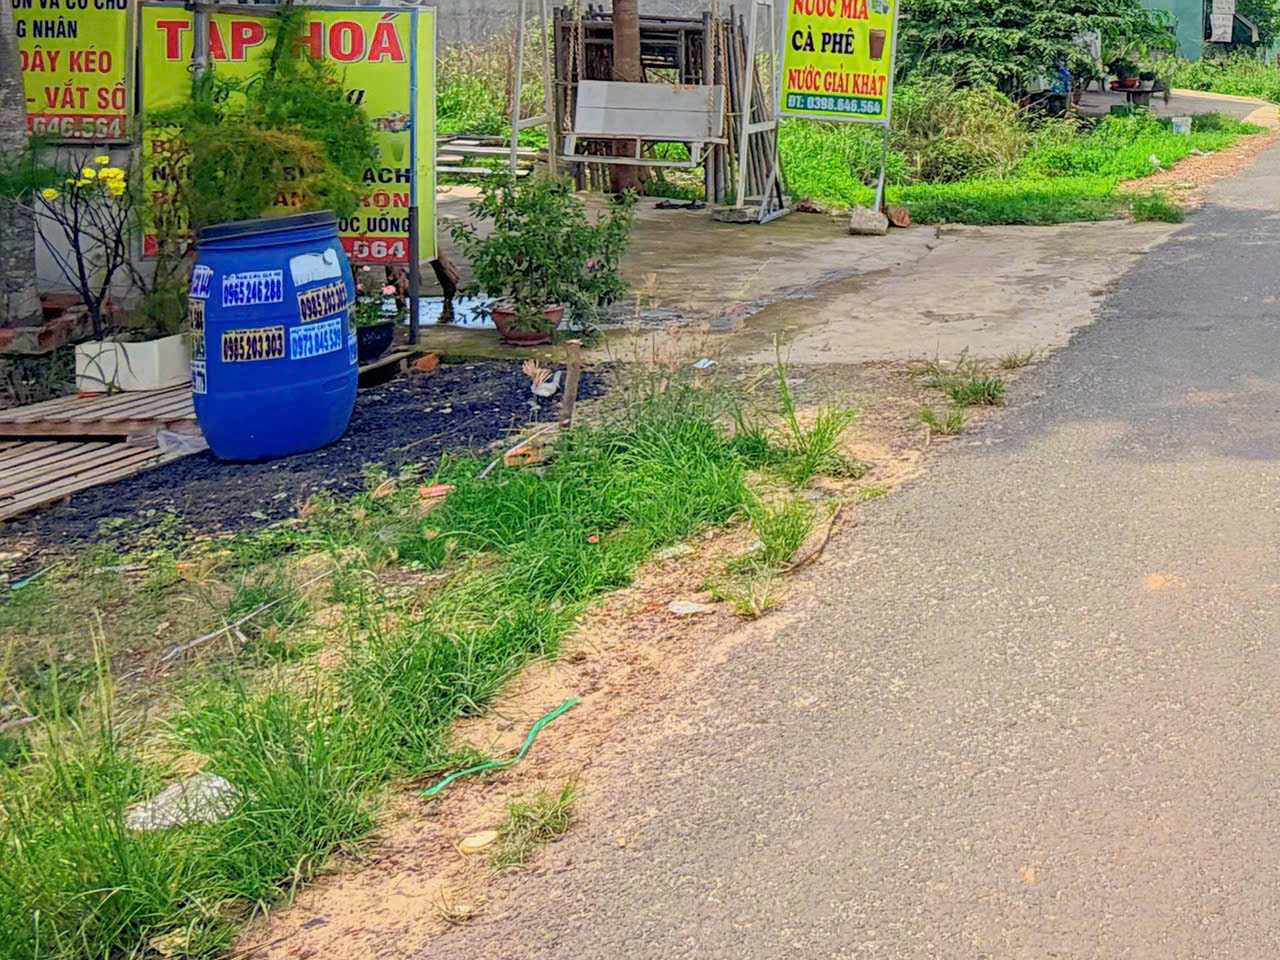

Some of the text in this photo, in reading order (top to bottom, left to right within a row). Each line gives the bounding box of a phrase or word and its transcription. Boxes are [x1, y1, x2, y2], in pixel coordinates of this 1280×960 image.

[33, 16, 78, 39] NHÂN
[792, 25, 855, 54] CÀ PHÊ
[70, 46, 113, 74] KÉO
[44, 79, 89, 109] VẮT
[788, 64, 821, 91] NƯỚC
[852, 69, 886, 96] KHÁT
[806, 96, 881, 114] 0398.646.564
